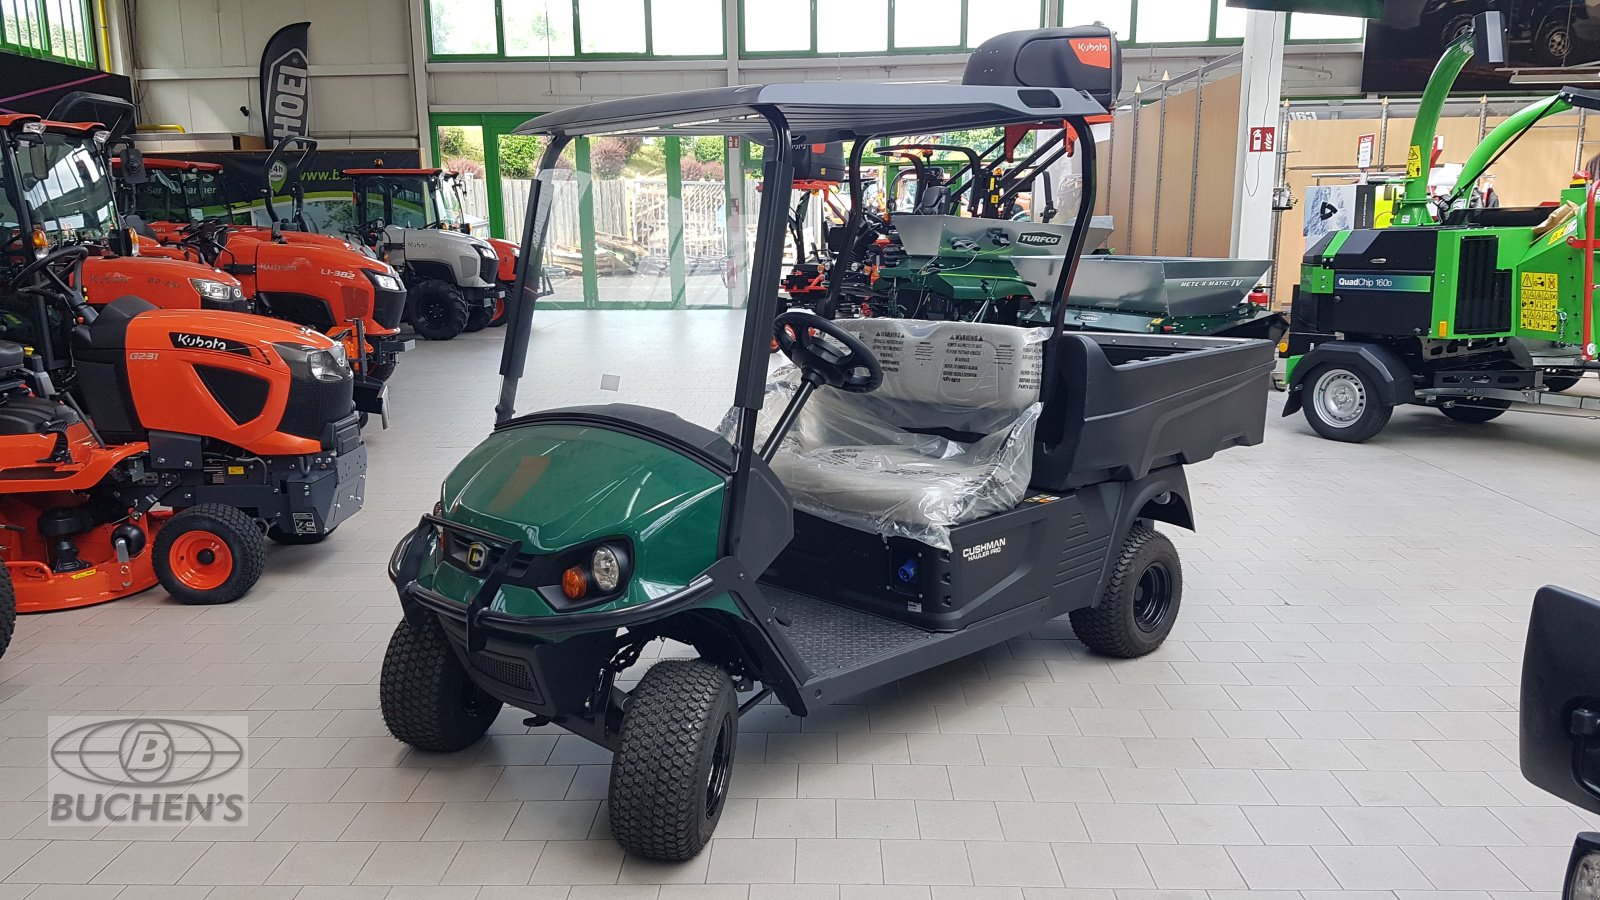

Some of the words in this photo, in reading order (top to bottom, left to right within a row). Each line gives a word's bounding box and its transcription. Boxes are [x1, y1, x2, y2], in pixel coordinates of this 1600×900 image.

[1077, 42, 1108, 52] Kubota
[270, 165, 284, 173] 4h
[1021, 235, 1058, 244] TURFCO
[260, 262, 297, 271] Kubota
[1338, 278, 1374, 287] QuadChip
[177, 333, 227, 350] Kubota
[129, 352, 160, 361] G231
[962, 537, 1006, 558] CUSHMAN
[967, 550, 990, 562] HAULER
[990, 546, 1002, 555] PRO
